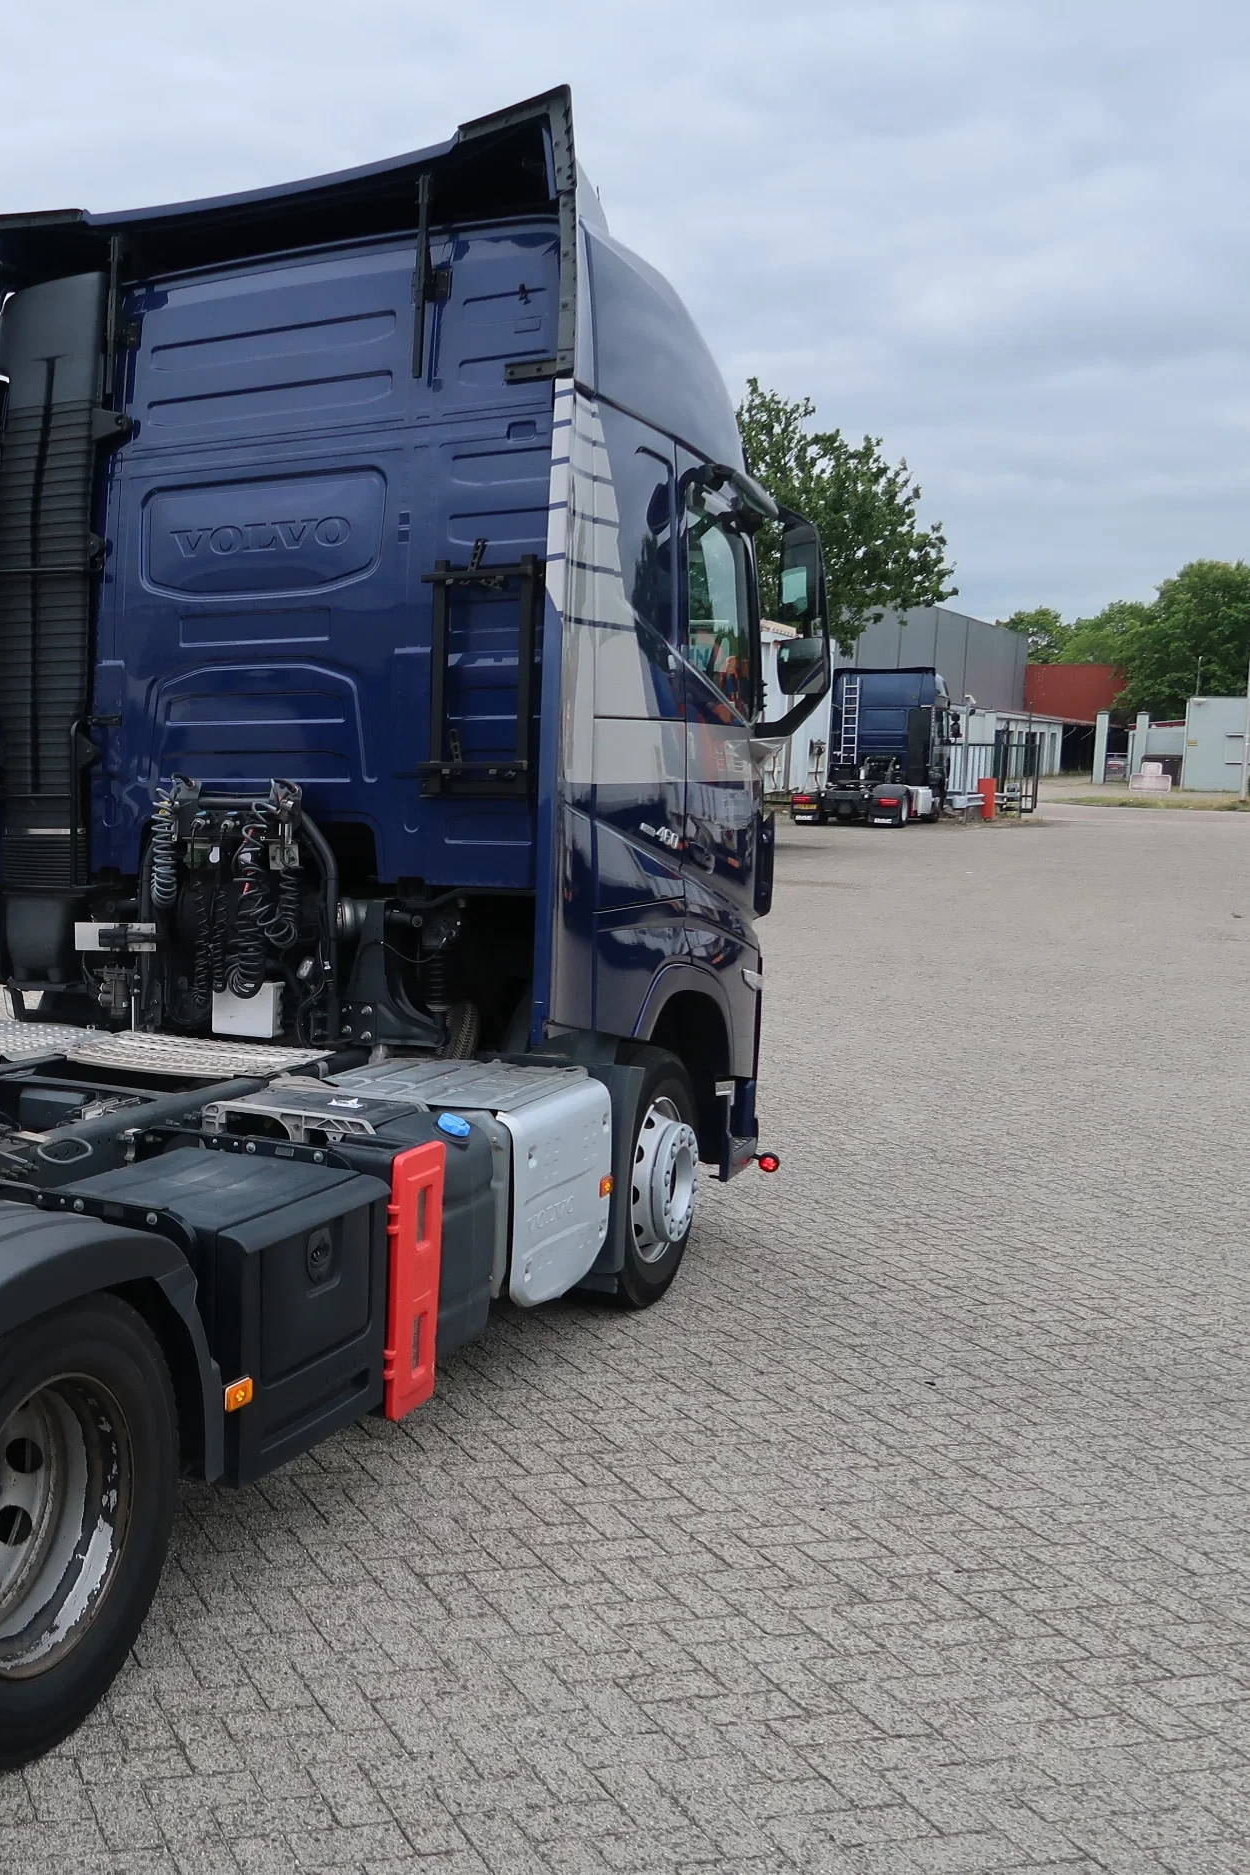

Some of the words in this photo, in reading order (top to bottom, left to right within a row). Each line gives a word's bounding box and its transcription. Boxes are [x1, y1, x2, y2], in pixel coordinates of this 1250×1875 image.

[170, 516, 351, 558] VOLVO
[656, 826, 679, 849] 460
[526, 1196, 575, 1234] VOLVO
